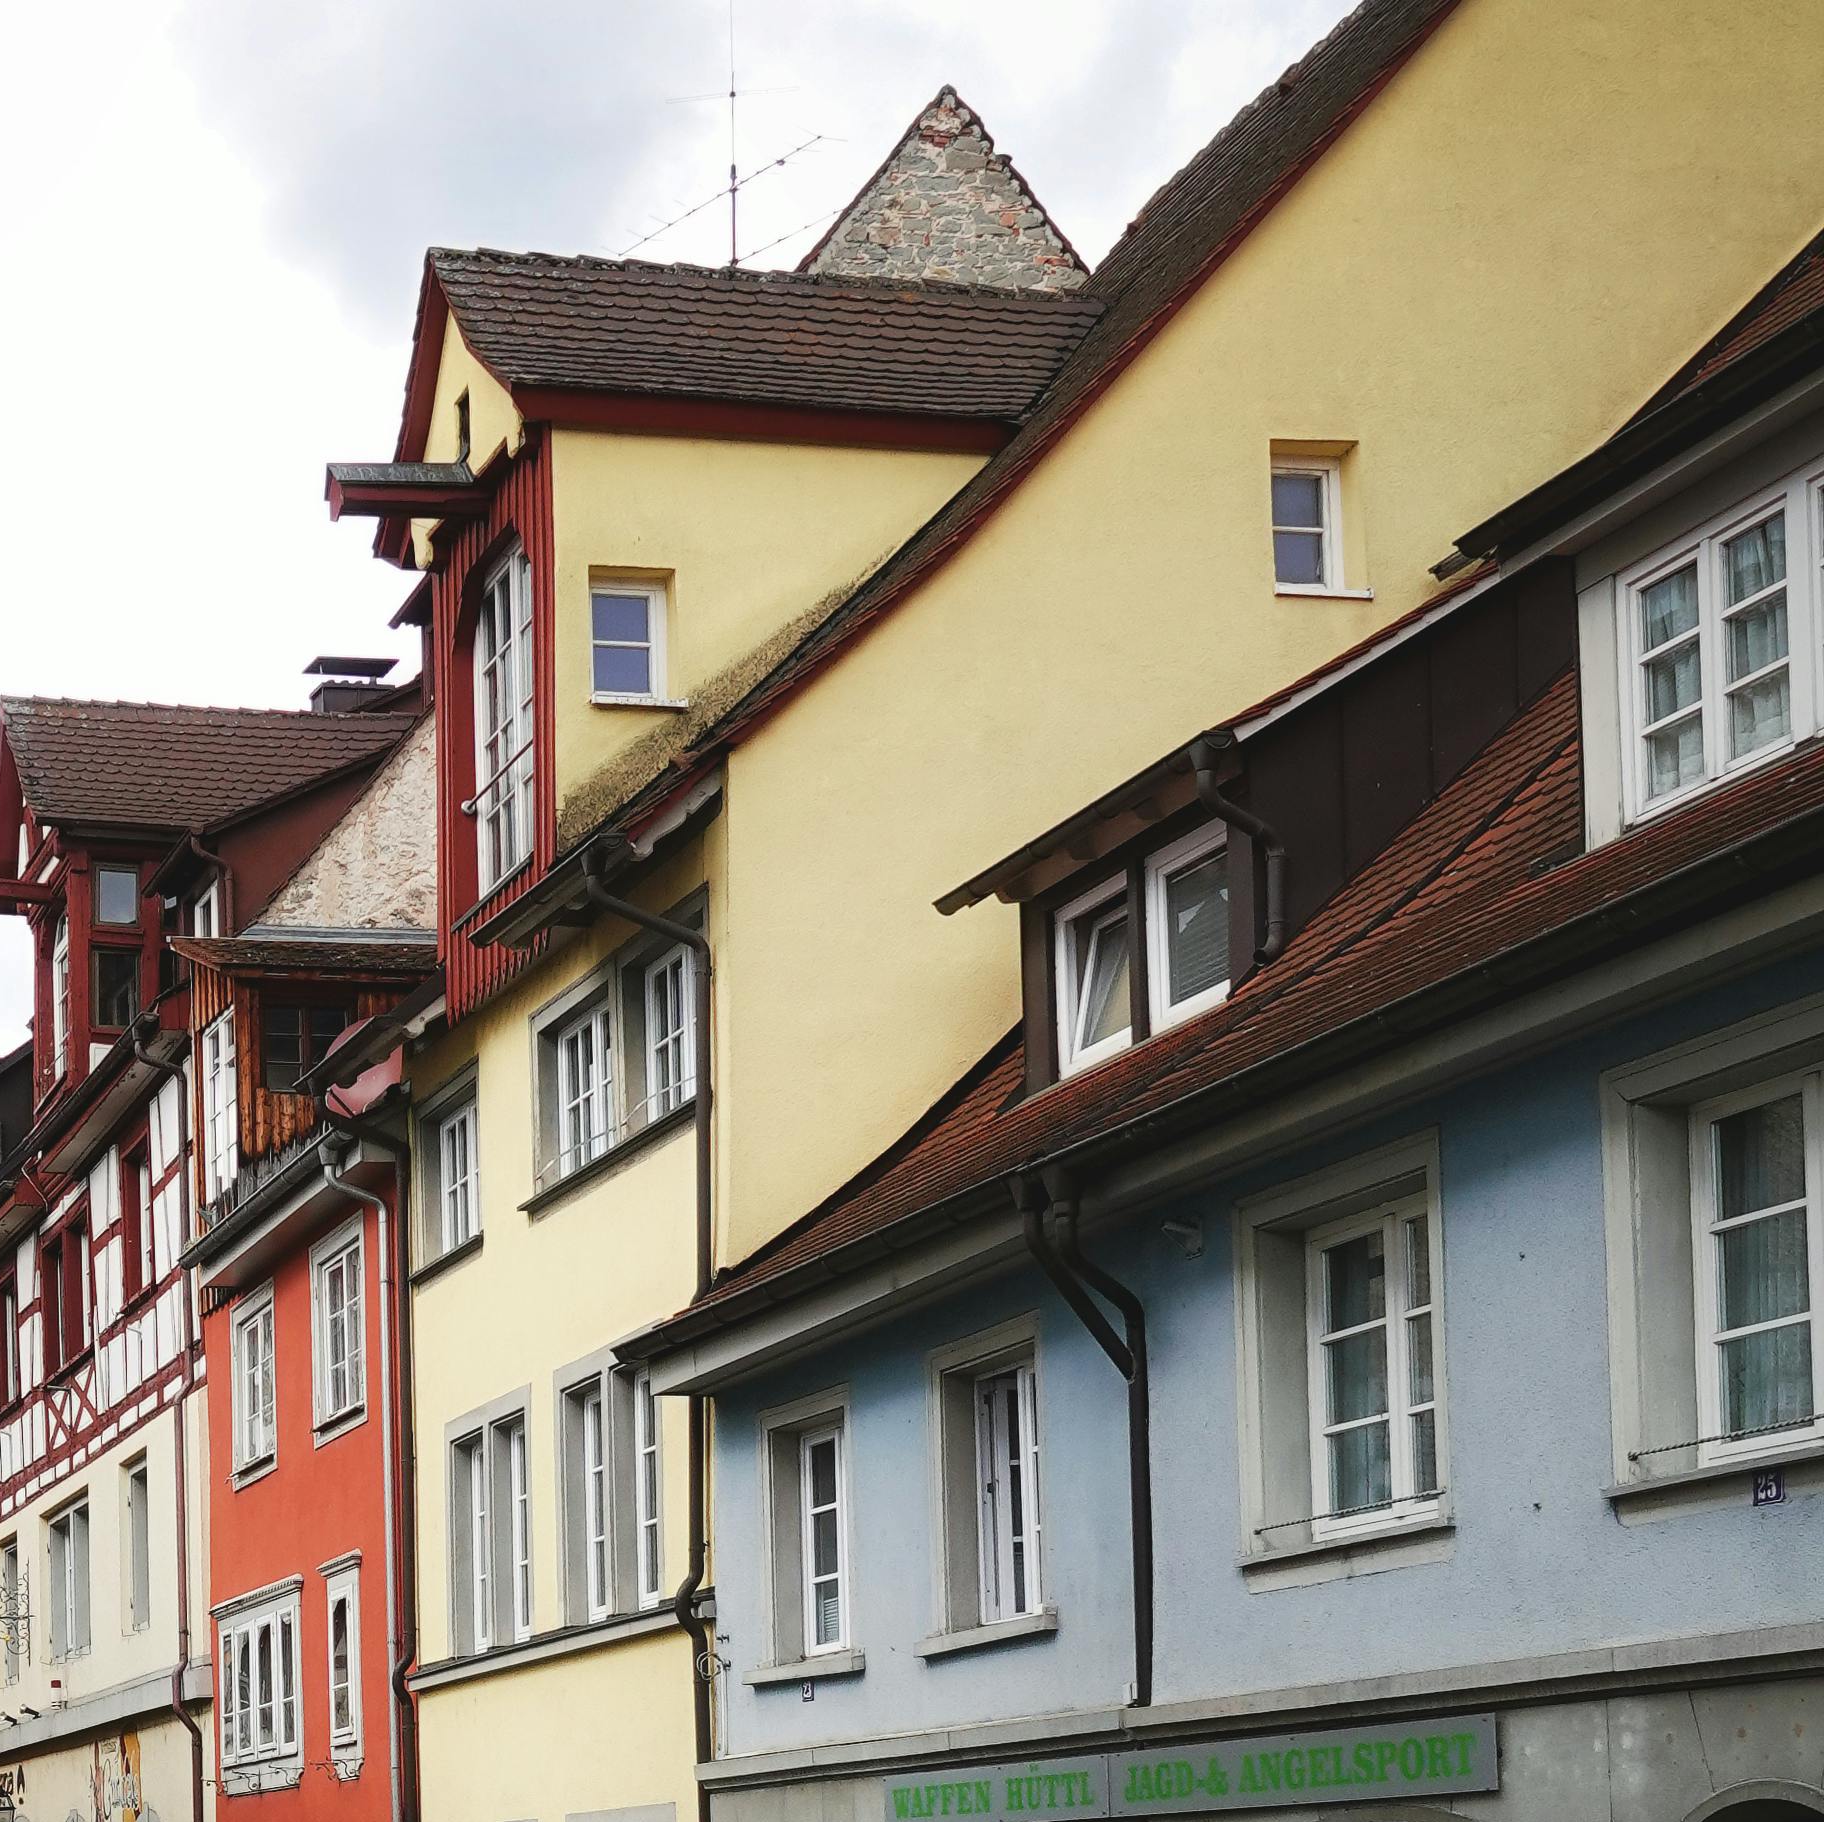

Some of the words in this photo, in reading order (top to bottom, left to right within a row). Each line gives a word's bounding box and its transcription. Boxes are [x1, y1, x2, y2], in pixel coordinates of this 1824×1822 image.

[1757, 1473, 1777, 1500] 25
[1237, 1732, 1474, 1794] ANGELSPORT
[892, 1780, 991, 1819] WAFFEN
[1005, 1764, 1095, 1811] HÜTTL
